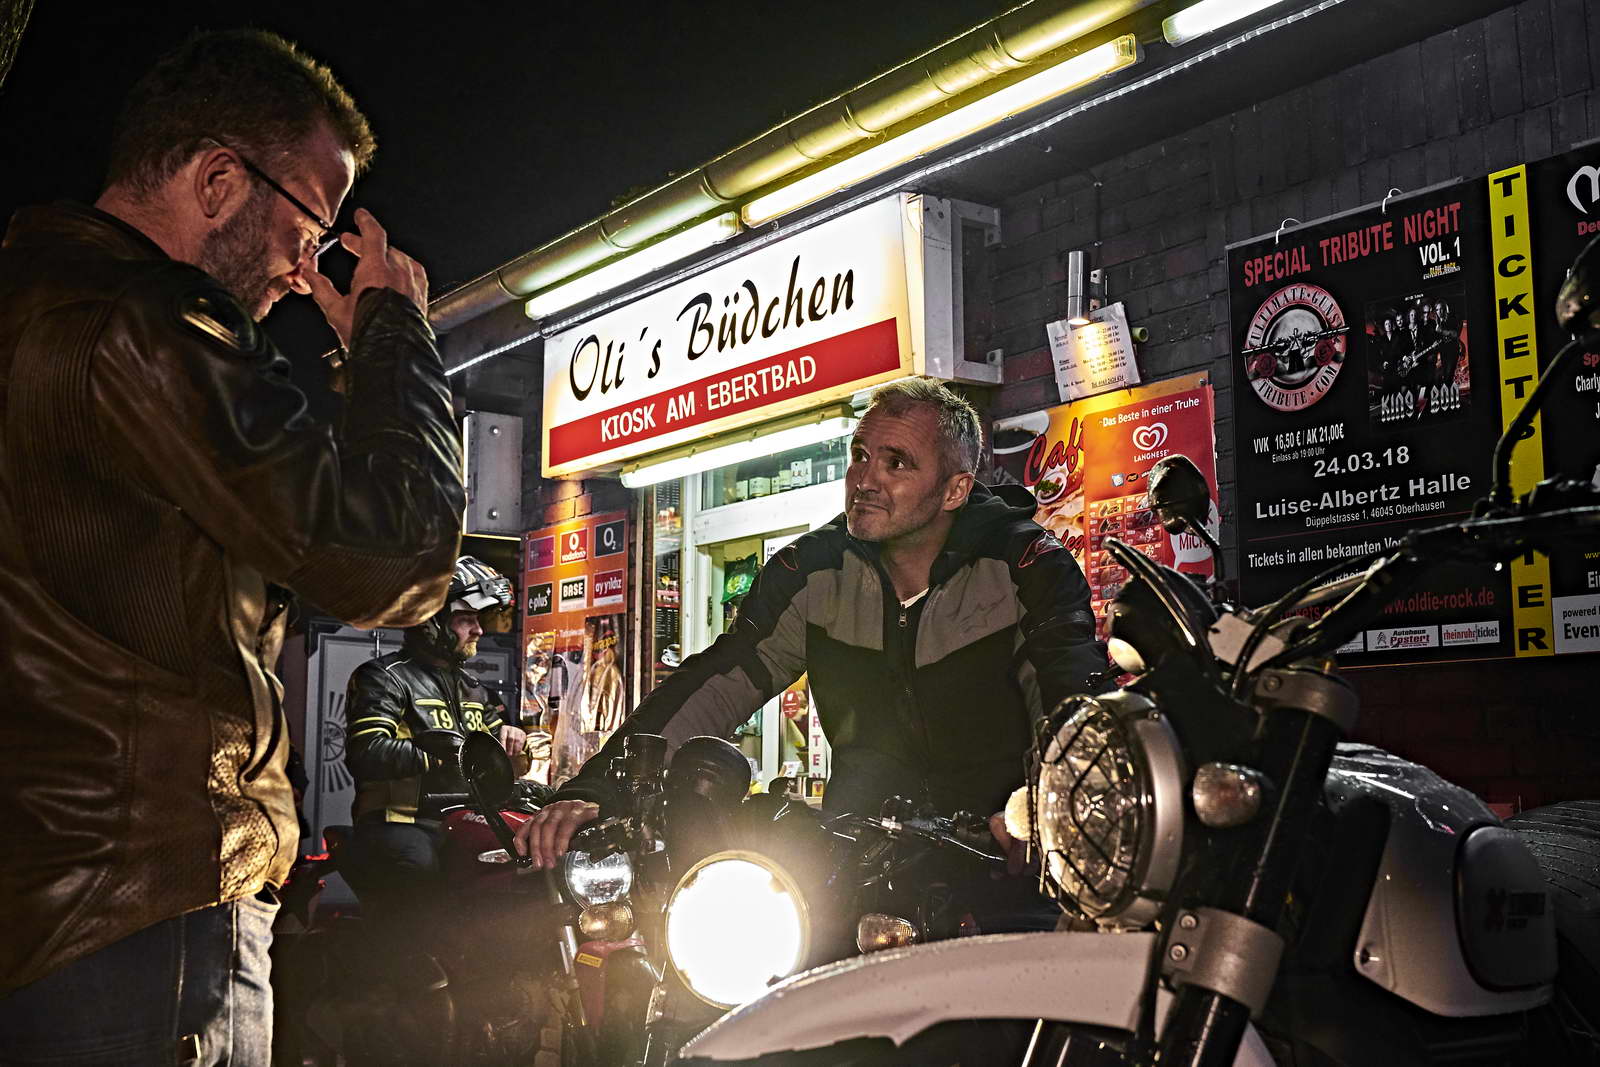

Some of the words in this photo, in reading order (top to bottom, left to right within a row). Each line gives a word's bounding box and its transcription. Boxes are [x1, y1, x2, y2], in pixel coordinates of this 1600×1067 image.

[1243, 250, 1311, 288] SPECIAL
[1319, 220, 1394, 267] TRIBUTE
[1403, 202, 1462, 245] NIGHT
[1419, 241, 1450, 266] VOL.
[1453, 236, 1461, 257] 1
[676, 254, 855, 361] Büdchen
[600, 402, 656, 443] KIOSK
[665, 390, 696, 424] AM
[706, 355, 817, 411] EBERTBAD
[1258, 380, 1308, 407] TRIBUTE
[1315, 365, 1338, 393] COM
[1102, 416, 1117, 428] Das
[1118, 410, 1140, 424] Beste
[1141, 408, 1150, 418] in
[1151, 404, 1173, 416] einer
[1175, 397, 1200, 411] Truhe
[1023, 416, 1084, 487] Caf
[1253, 436, 1270, 454] VVK
[1275, 431, 1295, 452] 16,50
[1296, 430, 1301, 447] €
[1306, 427, 1318, 445] AK
[1272, 452, 1292, 463] Einlass
[1292, 451, 1299, 460] ab
[1315, 446, 1326, 456] Uhr
[1133, 449, 1168, 463] LANGNESE
[1313, 445, 1410, 478] 24.03.18
[1255, 483, 1401, 519] Luise-Albertz
[1408, 473, 1471, 497] Halle
[1305, 511, 1360, 528] Düppelstrasse
[1370, 506, 1395, 518] 46045
[1395, 499, 1446, 515] Oberhausen
[1248, 552, 1285, 568] Tickets
[1287, 549, 1297, 564] in
[1298, 547, 1324, 563] allen
[1326, 540, 1382, 560] bekannten
[562, 582, 584, 598] BASE
[1563, 605, 1597, 620] powered
[1564, 622, 1600, 640] Even
[429, 708, 454, 730] 19
[464, 710, 484, 732] 38
